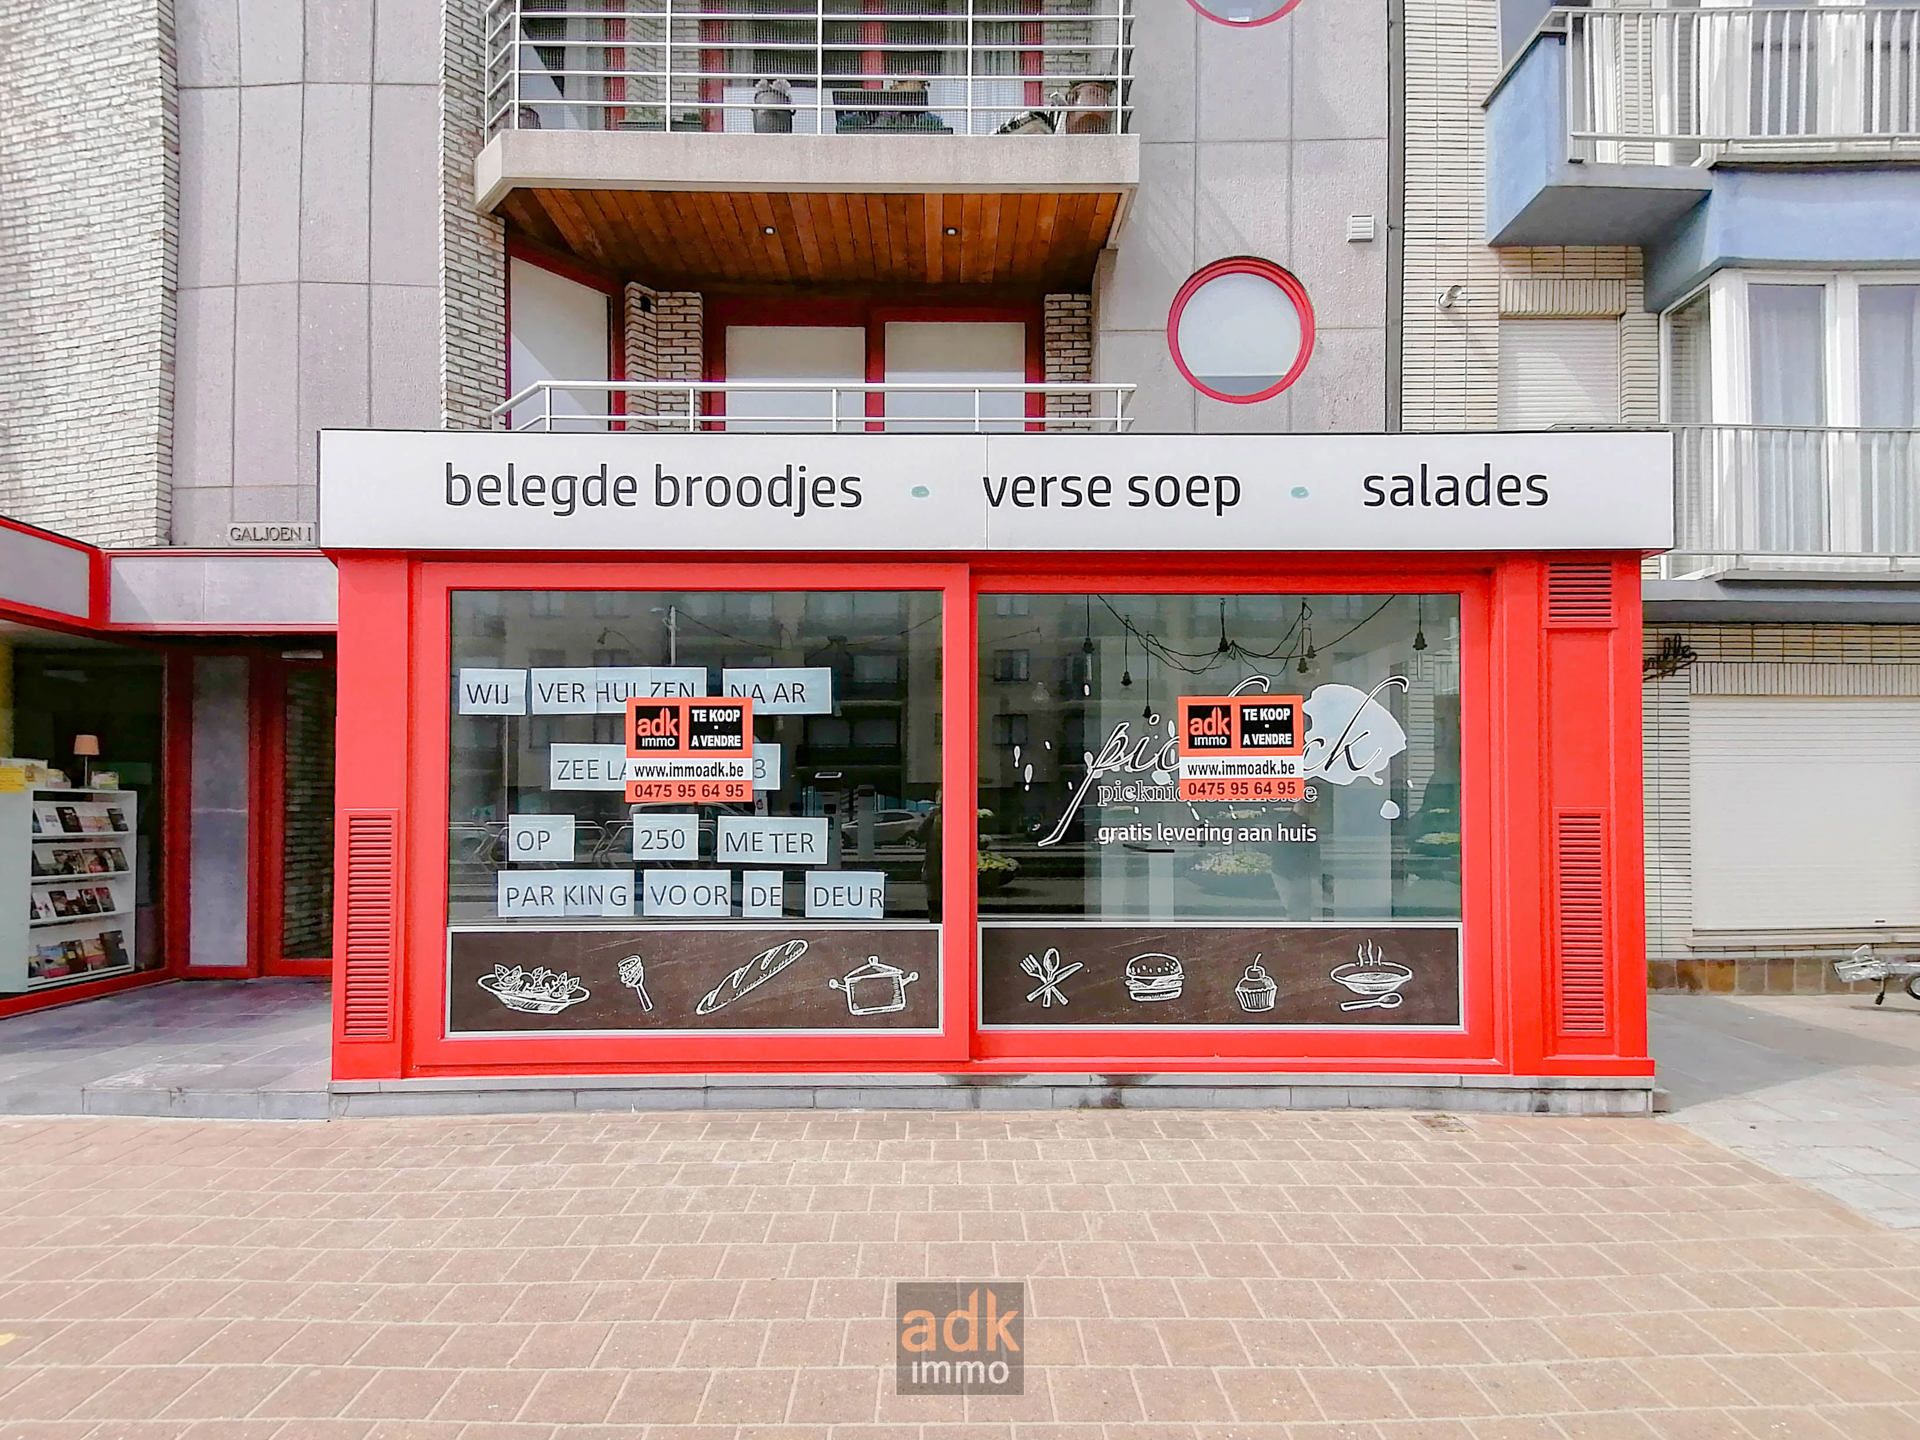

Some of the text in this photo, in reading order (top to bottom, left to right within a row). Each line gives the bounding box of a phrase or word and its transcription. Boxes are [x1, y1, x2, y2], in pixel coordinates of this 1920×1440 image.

[445, 462, 1549, 517] belegde broodjes verse soep salades
[230, 527, 302, 541] GALJOEN
[466, 683, 509, 705] WIJ
[730, 682, 806, 704] NAAR
[637, 707, 679, 736] adk
[691, 709, 741, 722] TE KOOP
[1189, 707, 1230, 735] adk
[1242, 707, 1291, 721] TE KOOP
[642, 737, 676, 747] immo
[691, 735, 742, 747] A VENDRE
[1194, 736, 1228, 746] immo
[1242, 733, 1292, 746] A VENDRE
[634, 762, 744, 777] www.immoadk.be
[1187, 760, 1296, 776] www.immoadk.be
[634, 784, 744, 798] 0475 95 64 95
[1188, 781, 1296, 796] 0475 95 64 95
[516, 828, 815, 853] OP 250 METER
[1098, 823, 1317, 844] gratis levering aan huis
[506, 884, 883, 909] PARKING VOOR DE DEUR
